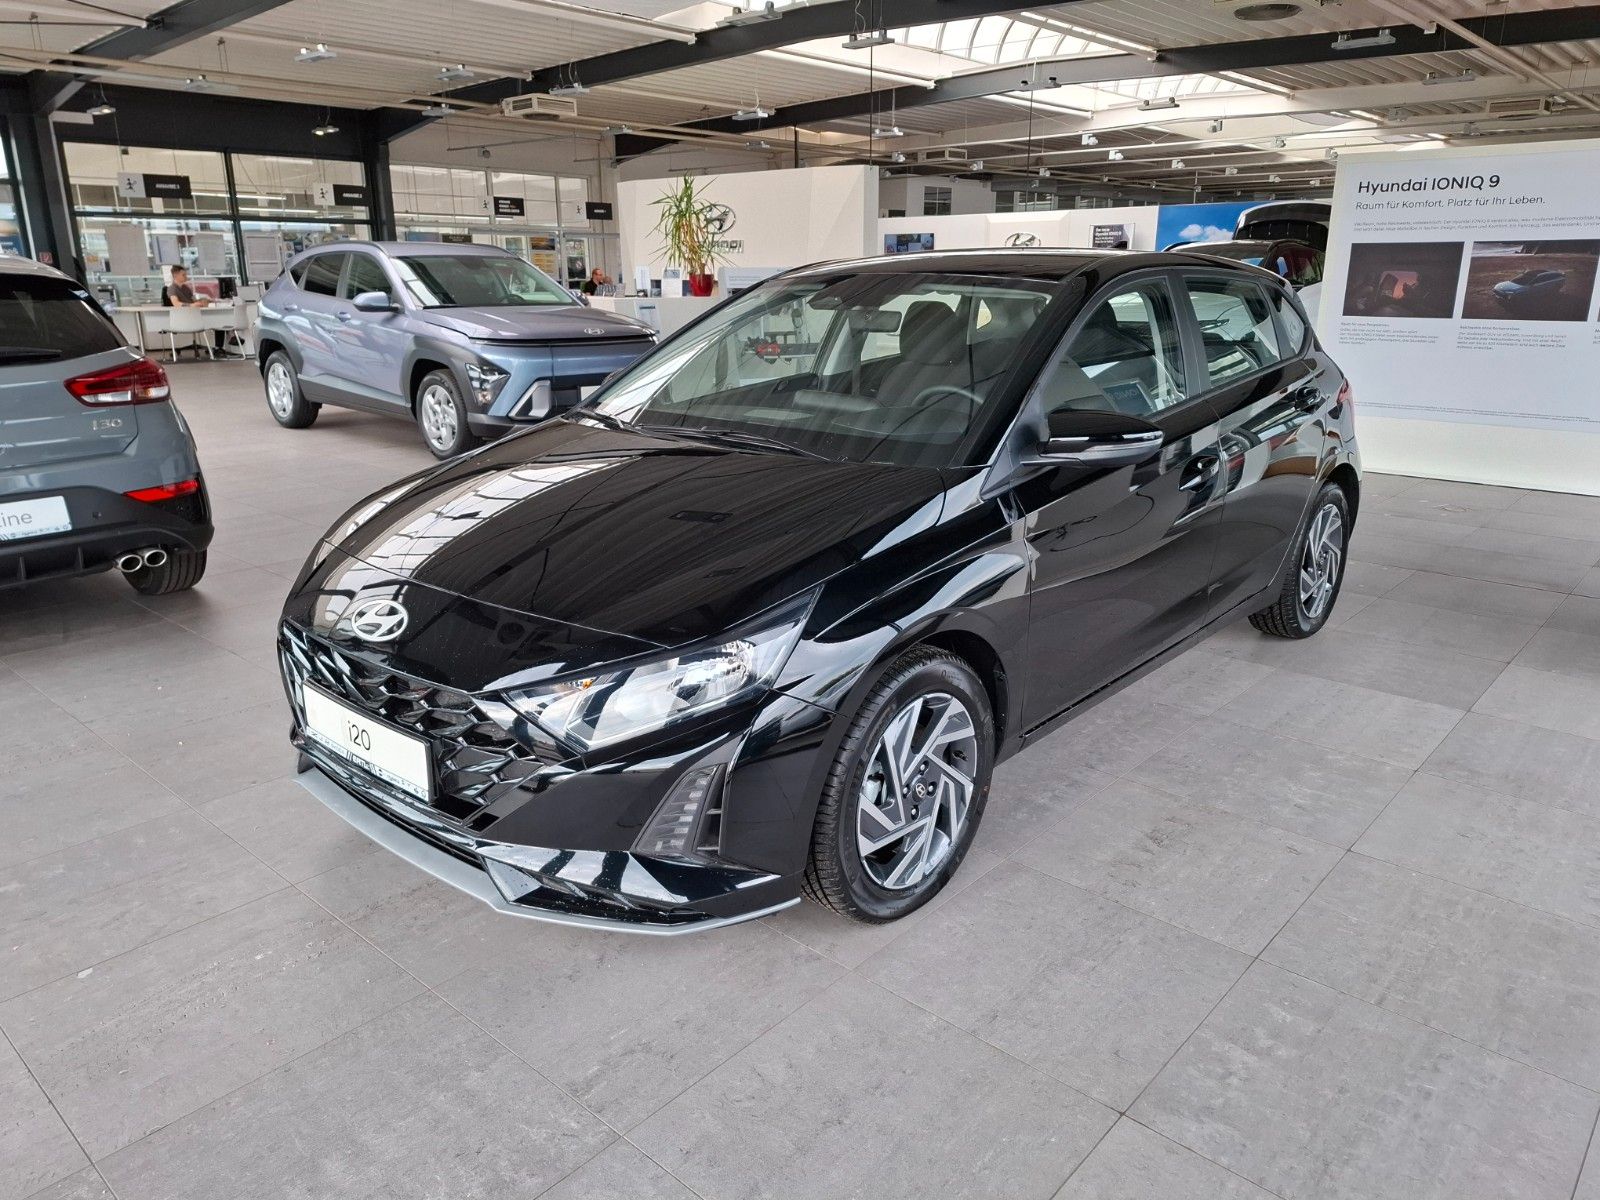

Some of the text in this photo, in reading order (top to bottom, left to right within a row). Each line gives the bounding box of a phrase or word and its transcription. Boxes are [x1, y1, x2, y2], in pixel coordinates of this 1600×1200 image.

[1358, 174, 1501, 196] Hyundai IONIQ 9
[1355, 201, 1384, 211] Raum
[1386, 200, 1400, 210] für
[1447, 198, 1472, 207] Platz
[1474, 197, 1489, 207] für
[1492, 196, 1506, 206] Ihr
[1509, 195, 1546, 206] Leben.
[0, 511, 33, 528] ine
[347, 720, 371, 751] i20
